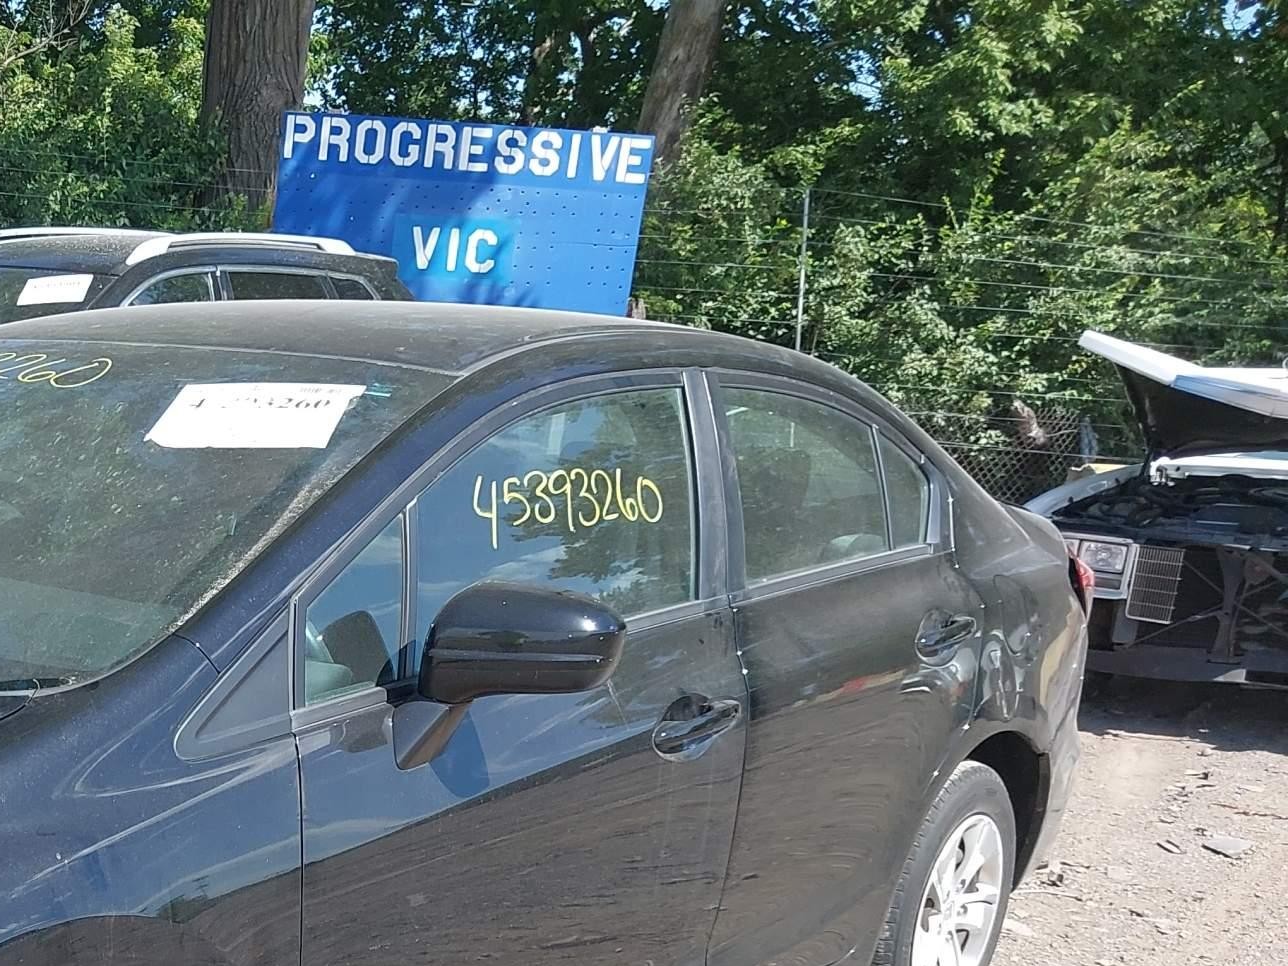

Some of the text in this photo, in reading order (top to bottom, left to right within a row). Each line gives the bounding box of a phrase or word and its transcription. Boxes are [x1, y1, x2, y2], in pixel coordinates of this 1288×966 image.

[283, 113, 653, 184] PROGRESSIVE
[413, 225, 498, 273] VIC
[473, 468, 663, 549] 45393260
